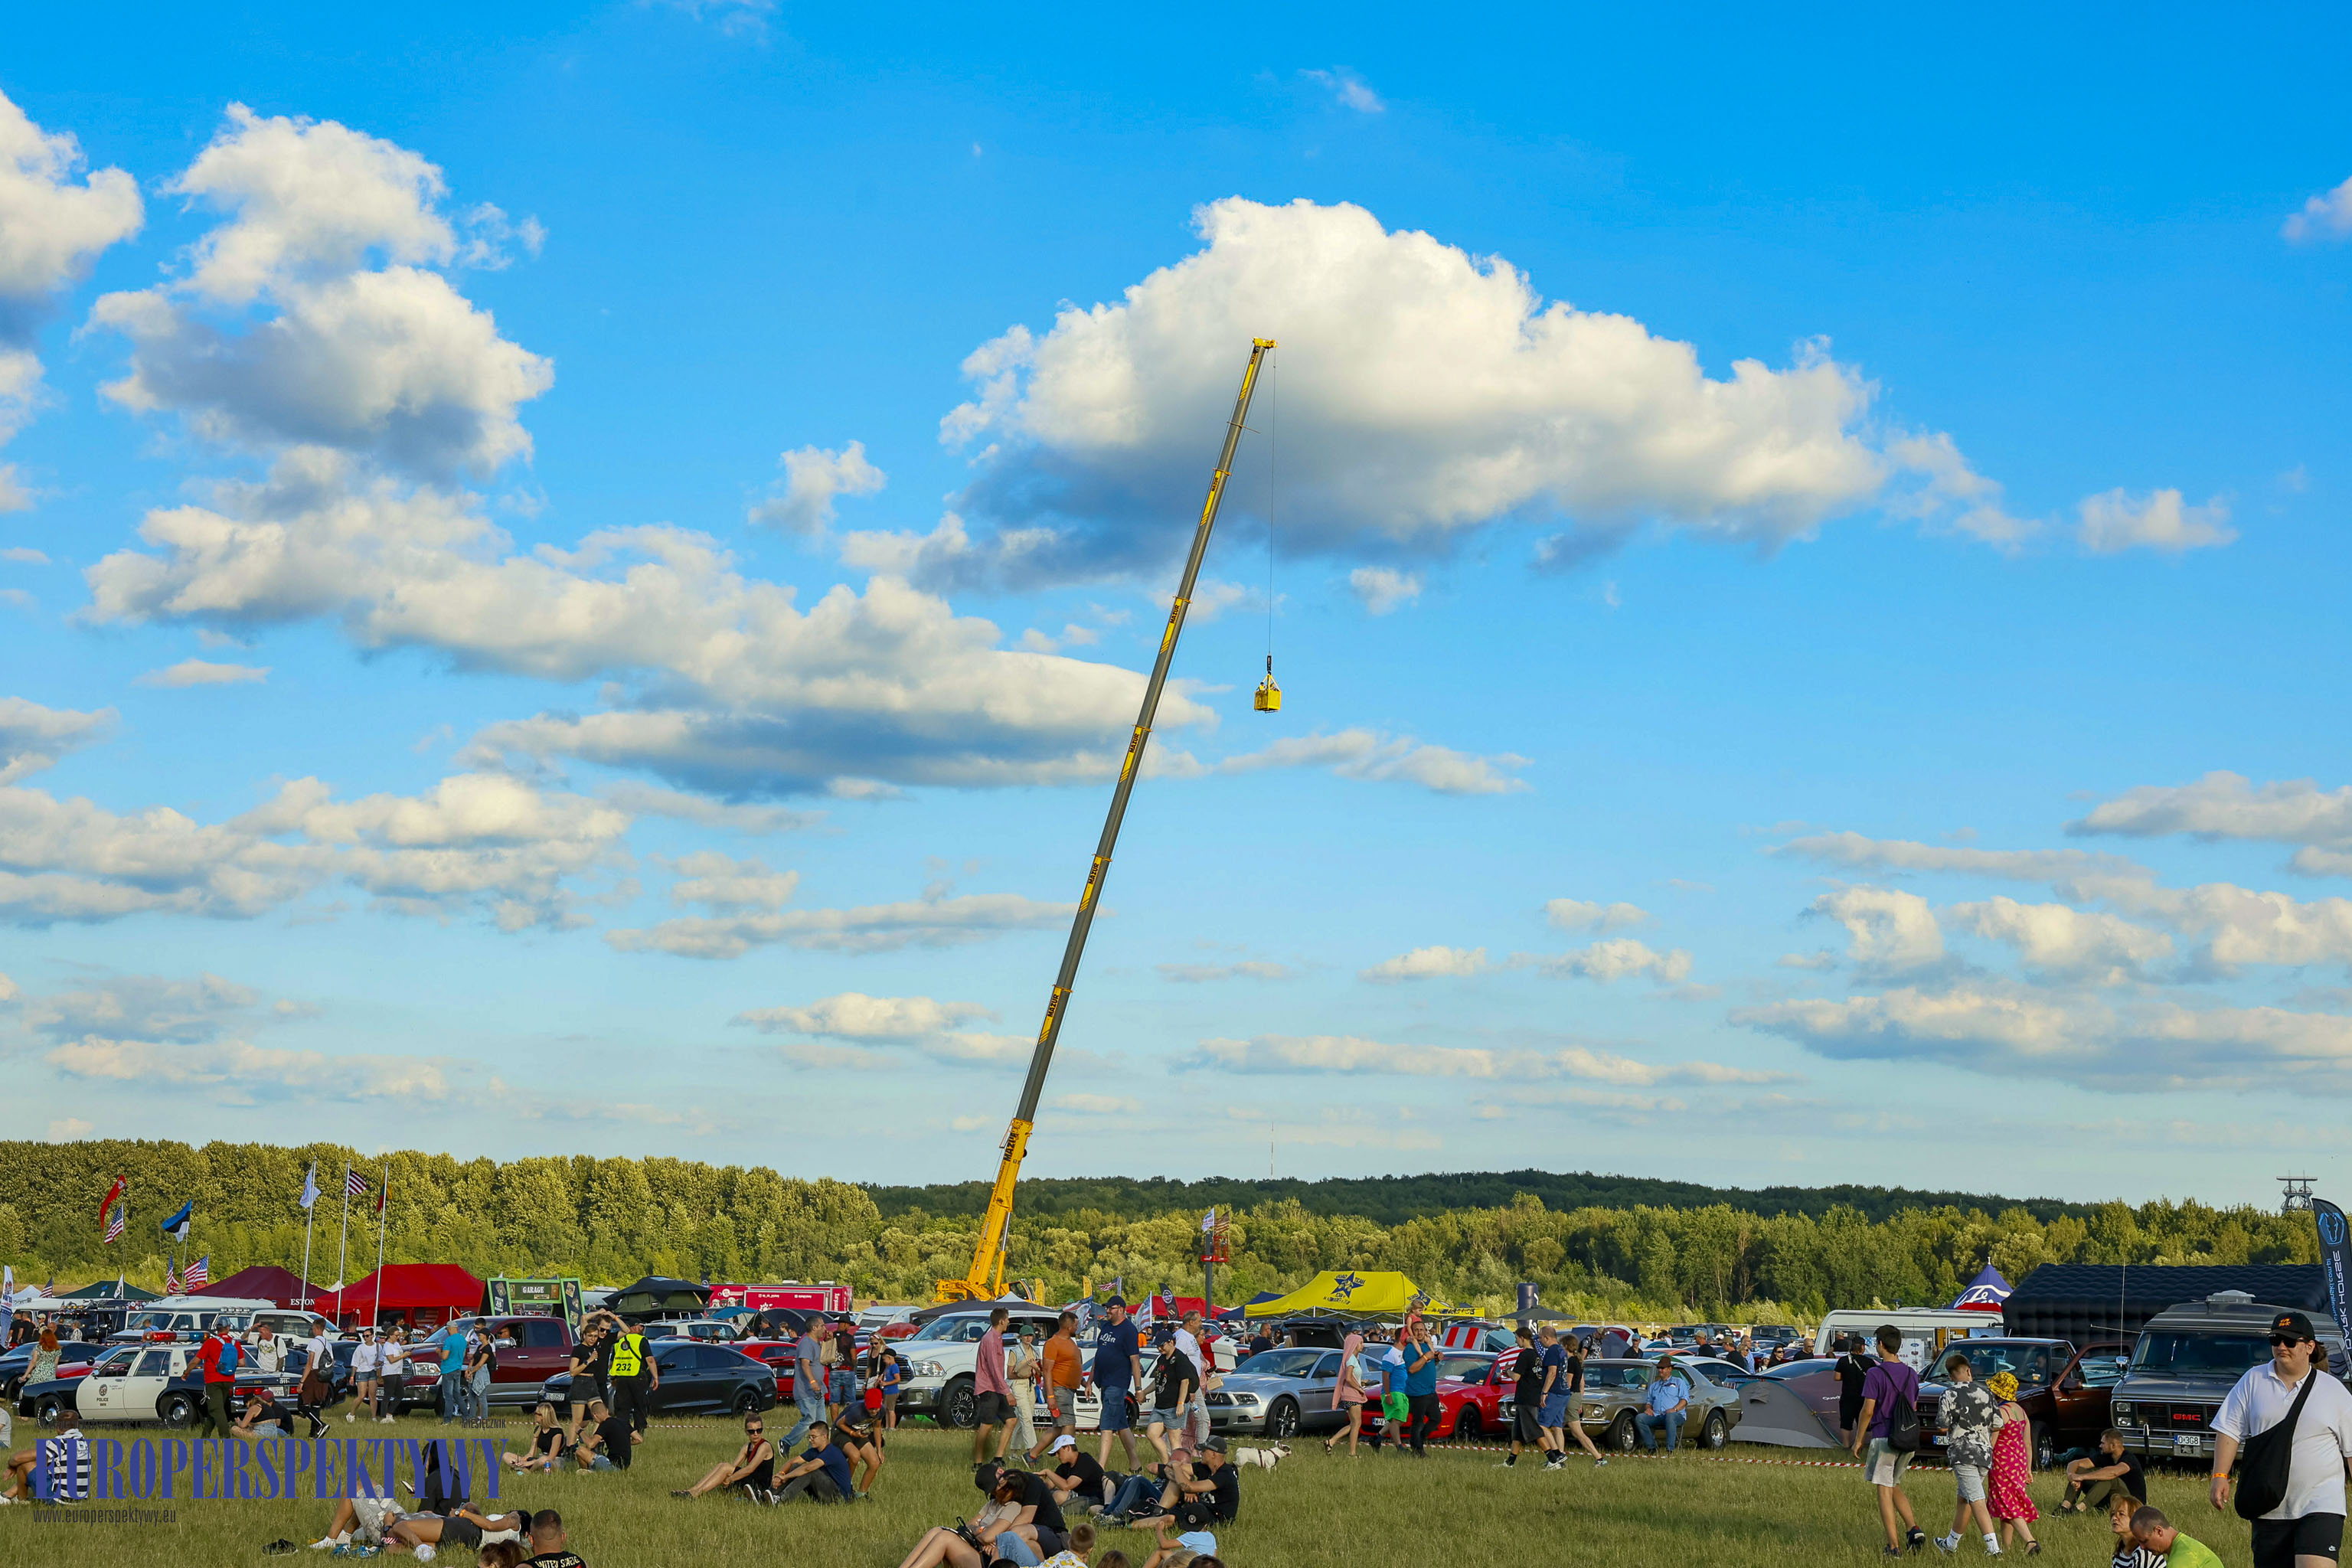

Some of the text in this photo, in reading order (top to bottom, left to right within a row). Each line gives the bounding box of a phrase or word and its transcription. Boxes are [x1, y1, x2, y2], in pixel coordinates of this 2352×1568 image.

[1169, 604, 1181, 624] MAZUR
[1129, 733, 1140, 753] MAZUR
[1088, 863, 1099, 885] MAZUR
[1047, 994, 1059, 1018] MAZUR
[616, 1363, 632, 1371] 232
[2172, 1413, 2201, 1421] GMC
